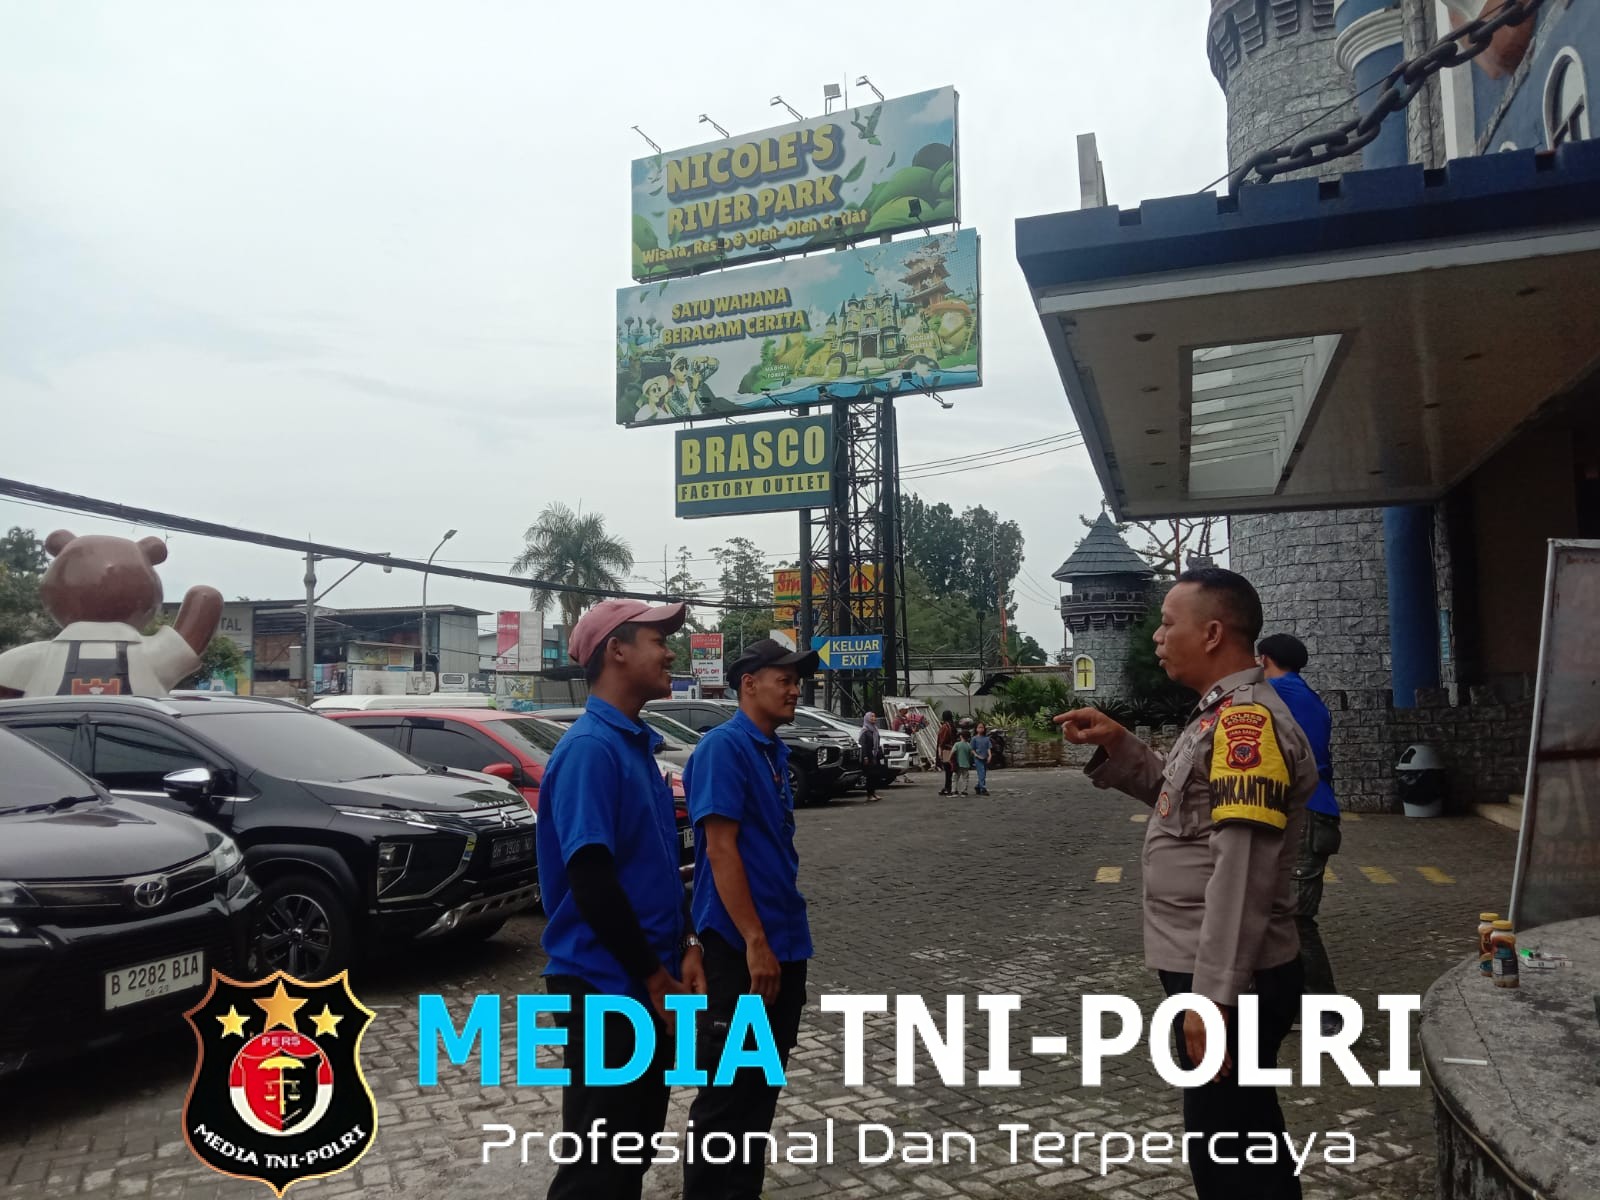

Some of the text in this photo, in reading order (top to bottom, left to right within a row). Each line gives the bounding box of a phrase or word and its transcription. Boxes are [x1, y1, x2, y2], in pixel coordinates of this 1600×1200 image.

[666, 123, 836, 196] NICOLE'S
[667, 175, 837, 237] RIVER PARK
[642, 242, 692, 264] Wisata,
[694, 237, 731, 254] Reso
[749, 221, 817, 244] Oleh-Oleh
[672, 288, 789, 322] SATU WAHANA
[663, 310, 806, 346] BERAGAM CERITA
[681, 425, 826, 477] BRASCO
[681, 474, 825, 500] FACTORY OUTLET
[832, 639, 880, 652] KELUAR
[841, 654, 869, 667] EXIT
[1223, 713, 1264, 723] POLRES
[111, 954, 199, 996] B 2282 BIA
